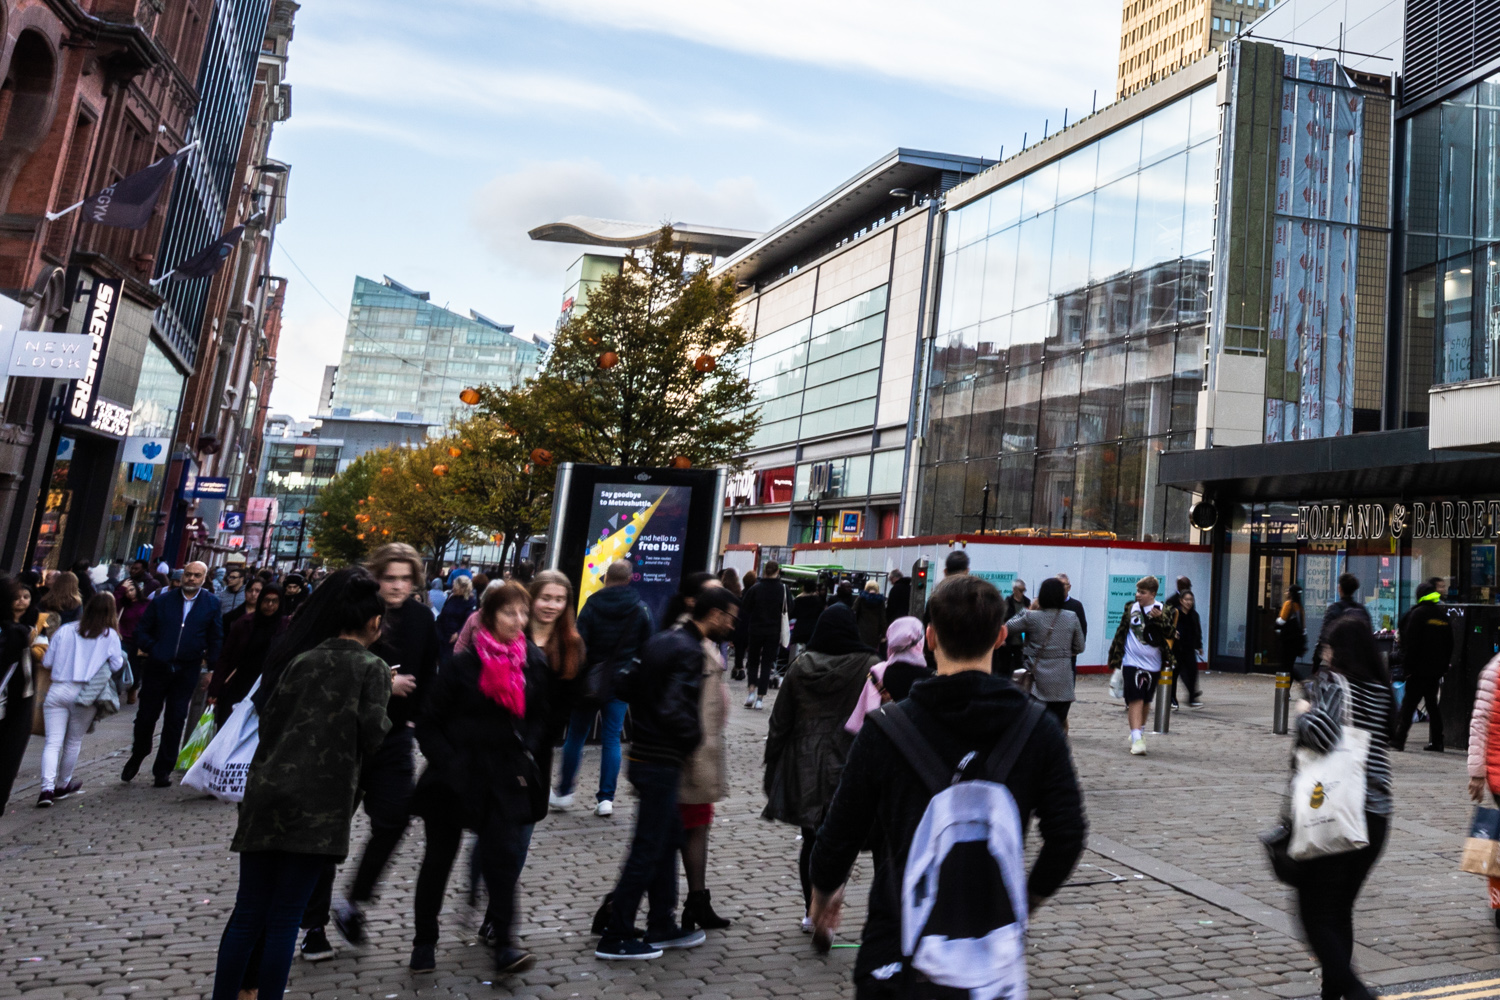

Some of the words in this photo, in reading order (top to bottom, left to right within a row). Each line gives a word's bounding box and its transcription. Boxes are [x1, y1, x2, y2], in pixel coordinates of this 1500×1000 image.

[26, 340, 80, 354] NEW
[70, 282, 114, 420] SKECHERS
[16, 356, 81, 368] LOOK
[601, 490, 612, 498] Say
[613, 491, 641, 499] goodbye
[1297, 504, 1385, 540] HOLLAND
[1390, 504, 1406, 539] &
[639, 542, 659, 551] free
[661, 543, 680, 551] bus
